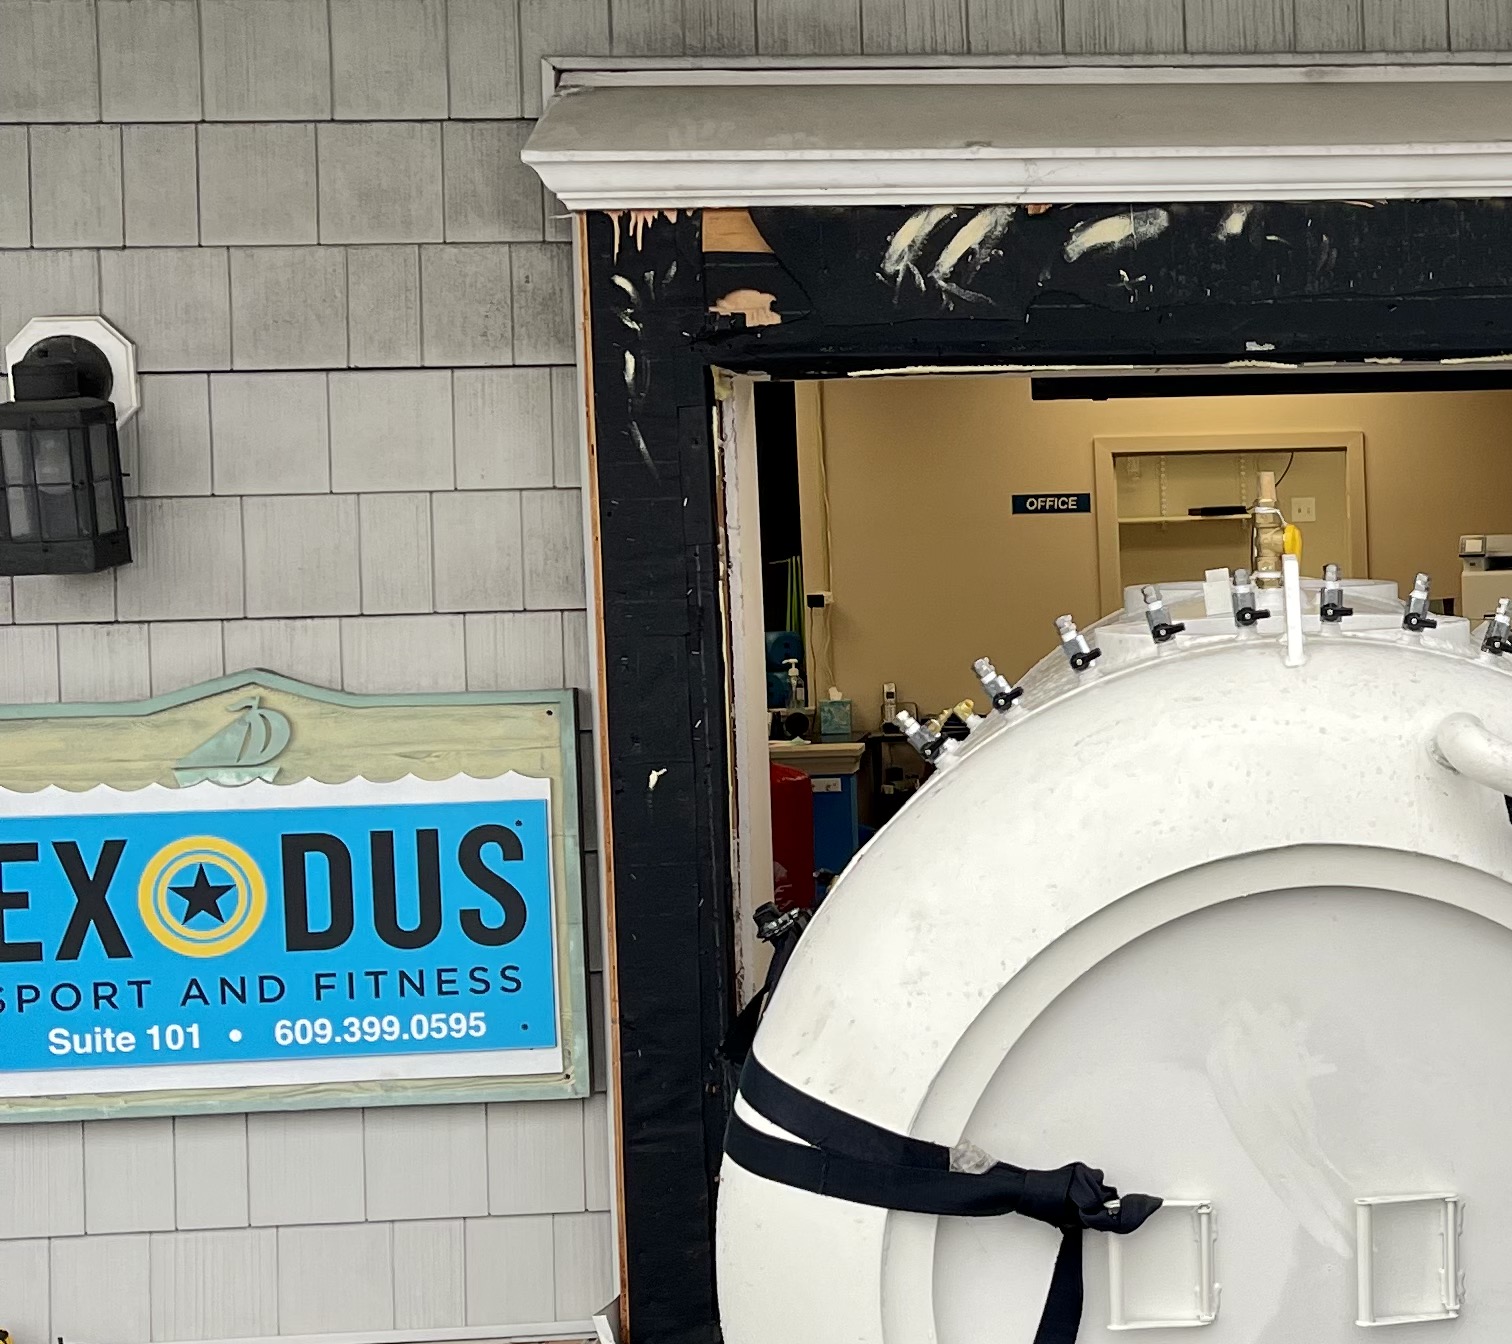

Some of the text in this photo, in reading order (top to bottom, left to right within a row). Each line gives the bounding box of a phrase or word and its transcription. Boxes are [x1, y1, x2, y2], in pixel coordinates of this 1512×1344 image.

[1026, 497, 1078, 510] OFFICE
[0, 964, 522, 1014] PORT AND FITNESS
[48, 1011, 487, 1056] Suite 101 609.399.0595
